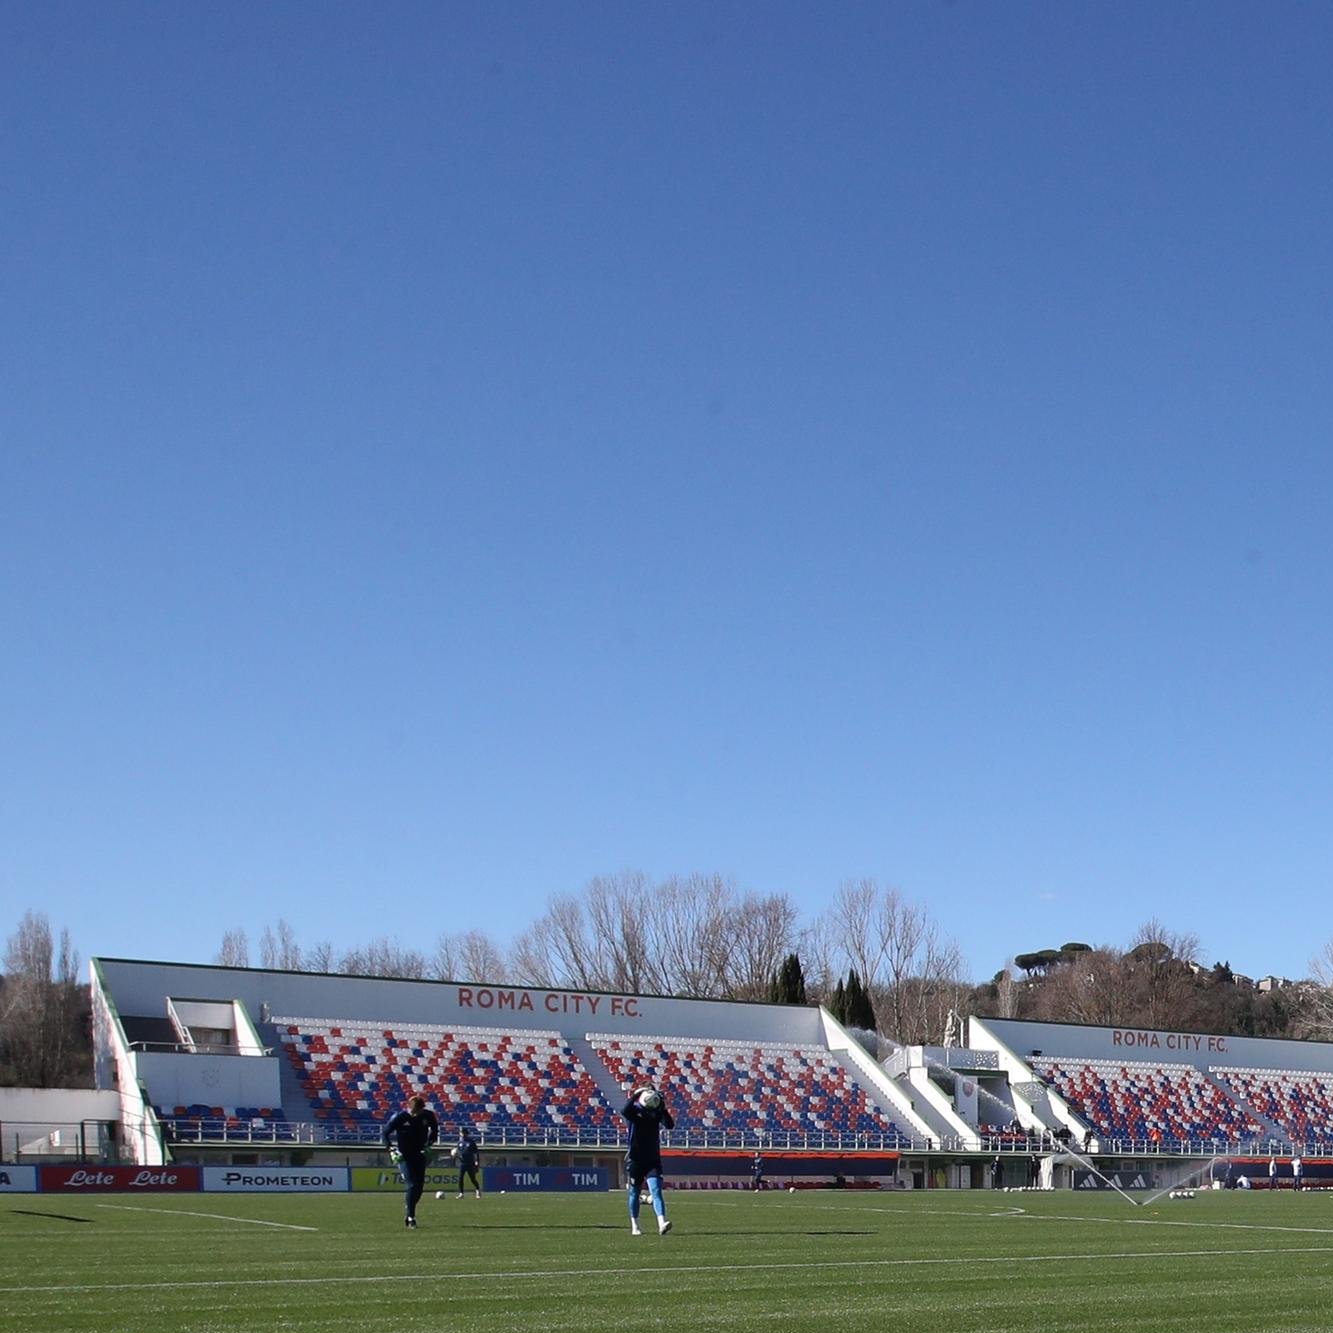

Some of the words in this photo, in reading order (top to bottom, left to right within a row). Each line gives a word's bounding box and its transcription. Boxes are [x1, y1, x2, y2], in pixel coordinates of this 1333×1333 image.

[458, 988, 534, 1011] ROMA
[545, 994, 600, 1014] CITY
[611, 998, 642, 1017] F.C.
[1113, 1030, 1160, 1048] ROMA
[1166, 1034, 1201, 1050] CITY
[1208, 1037, 1228, 1052] F.C.
[64, 1170, 114, 1186] Lete
[129, 1170, 177, 1186] Lete
[223, 1173, 333, 1185] PROMETEON
[513, 1173, 540, 1185] TIM
[572, 1173, 598, 1185] TIM
